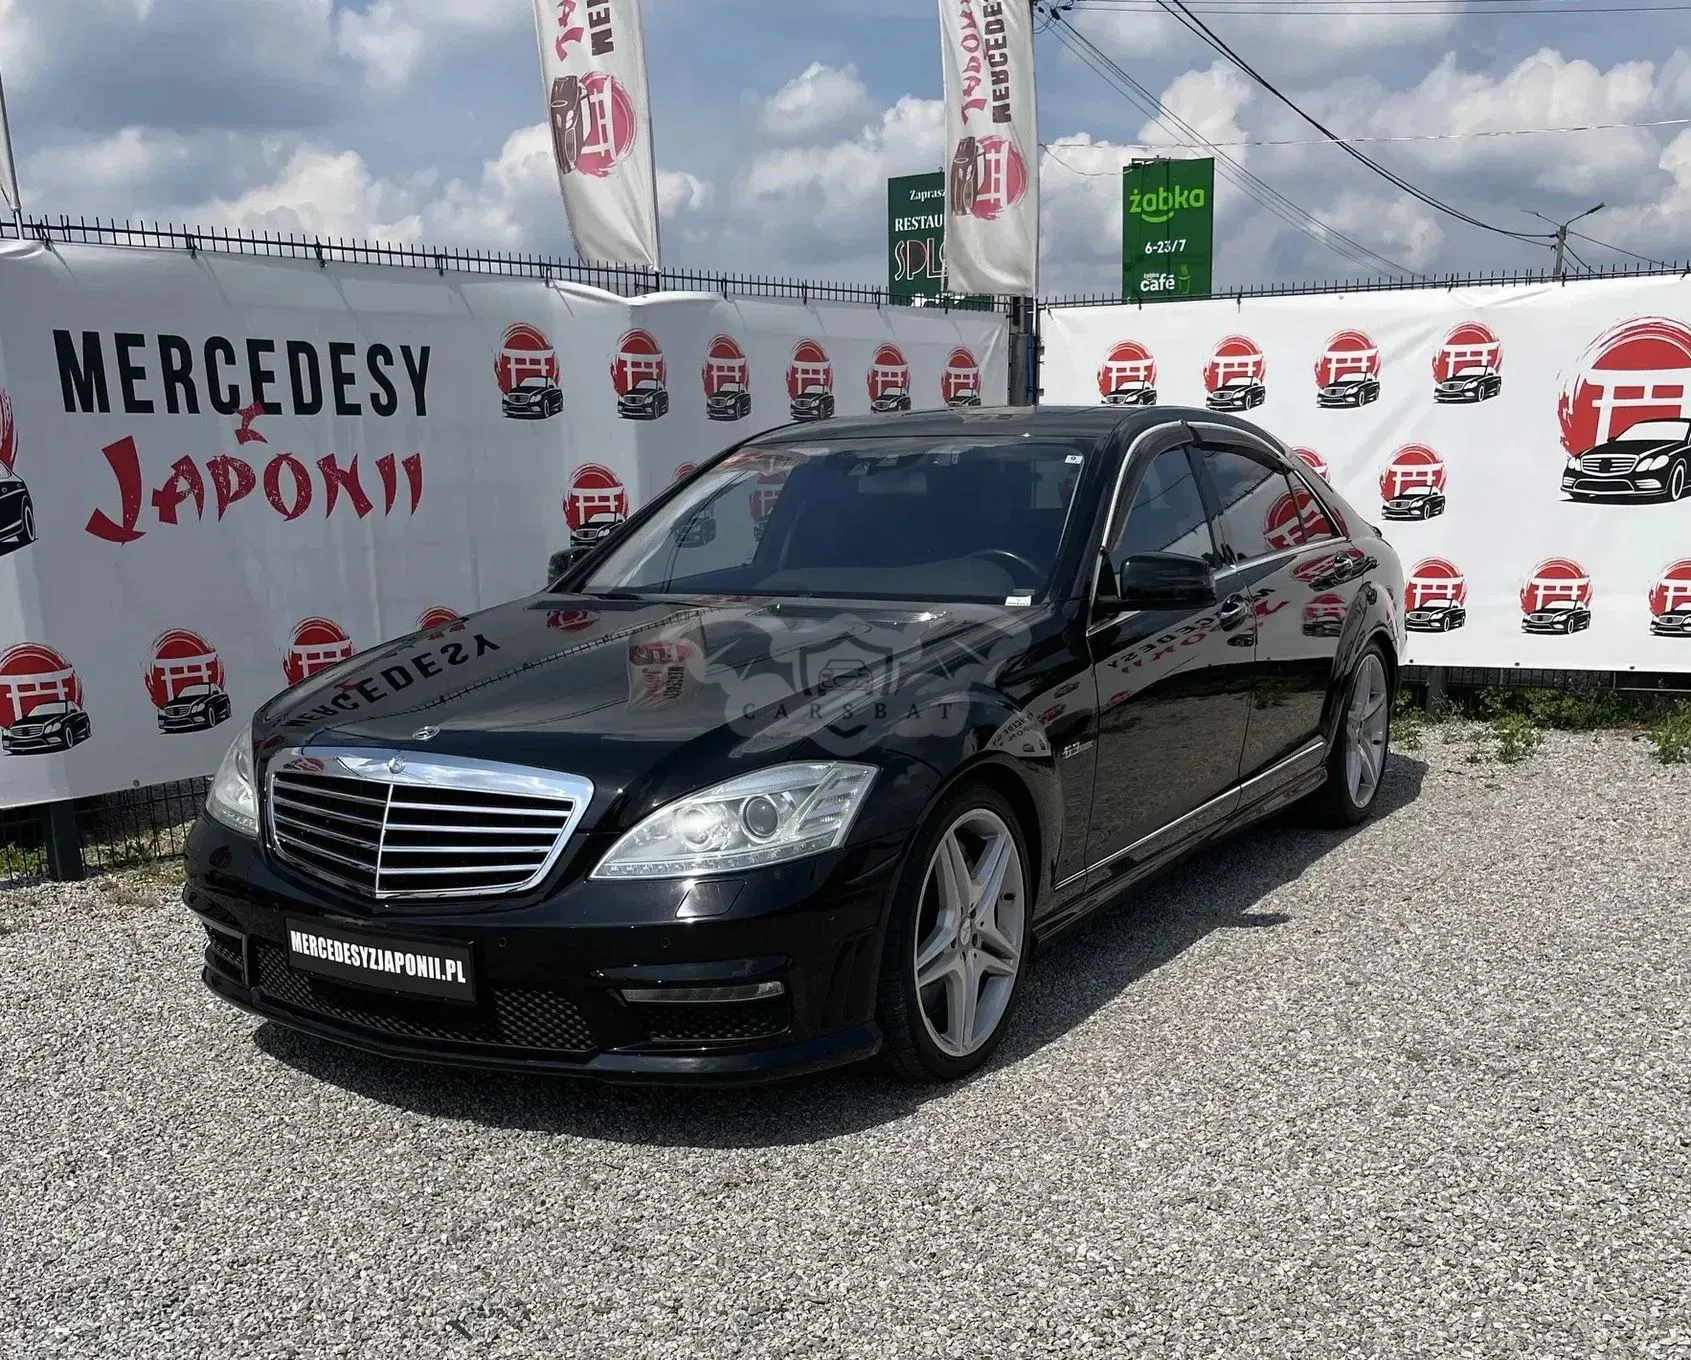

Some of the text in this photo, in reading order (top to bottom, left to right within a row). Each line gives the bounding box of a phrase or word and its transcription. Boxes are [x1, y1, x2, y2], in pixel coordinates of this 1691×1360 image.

[1129, 185, 1205, 214] żabka
[894, 213, 943, 232] RESTAU
[1144, 239, 1187, 255] 6-23/7
[1140, 273, 1176, 291] café
[53, 329, 431, 417] MERCEDESY
[290, 930, 466, 984] MERCEDESYZJAPONII.PL
